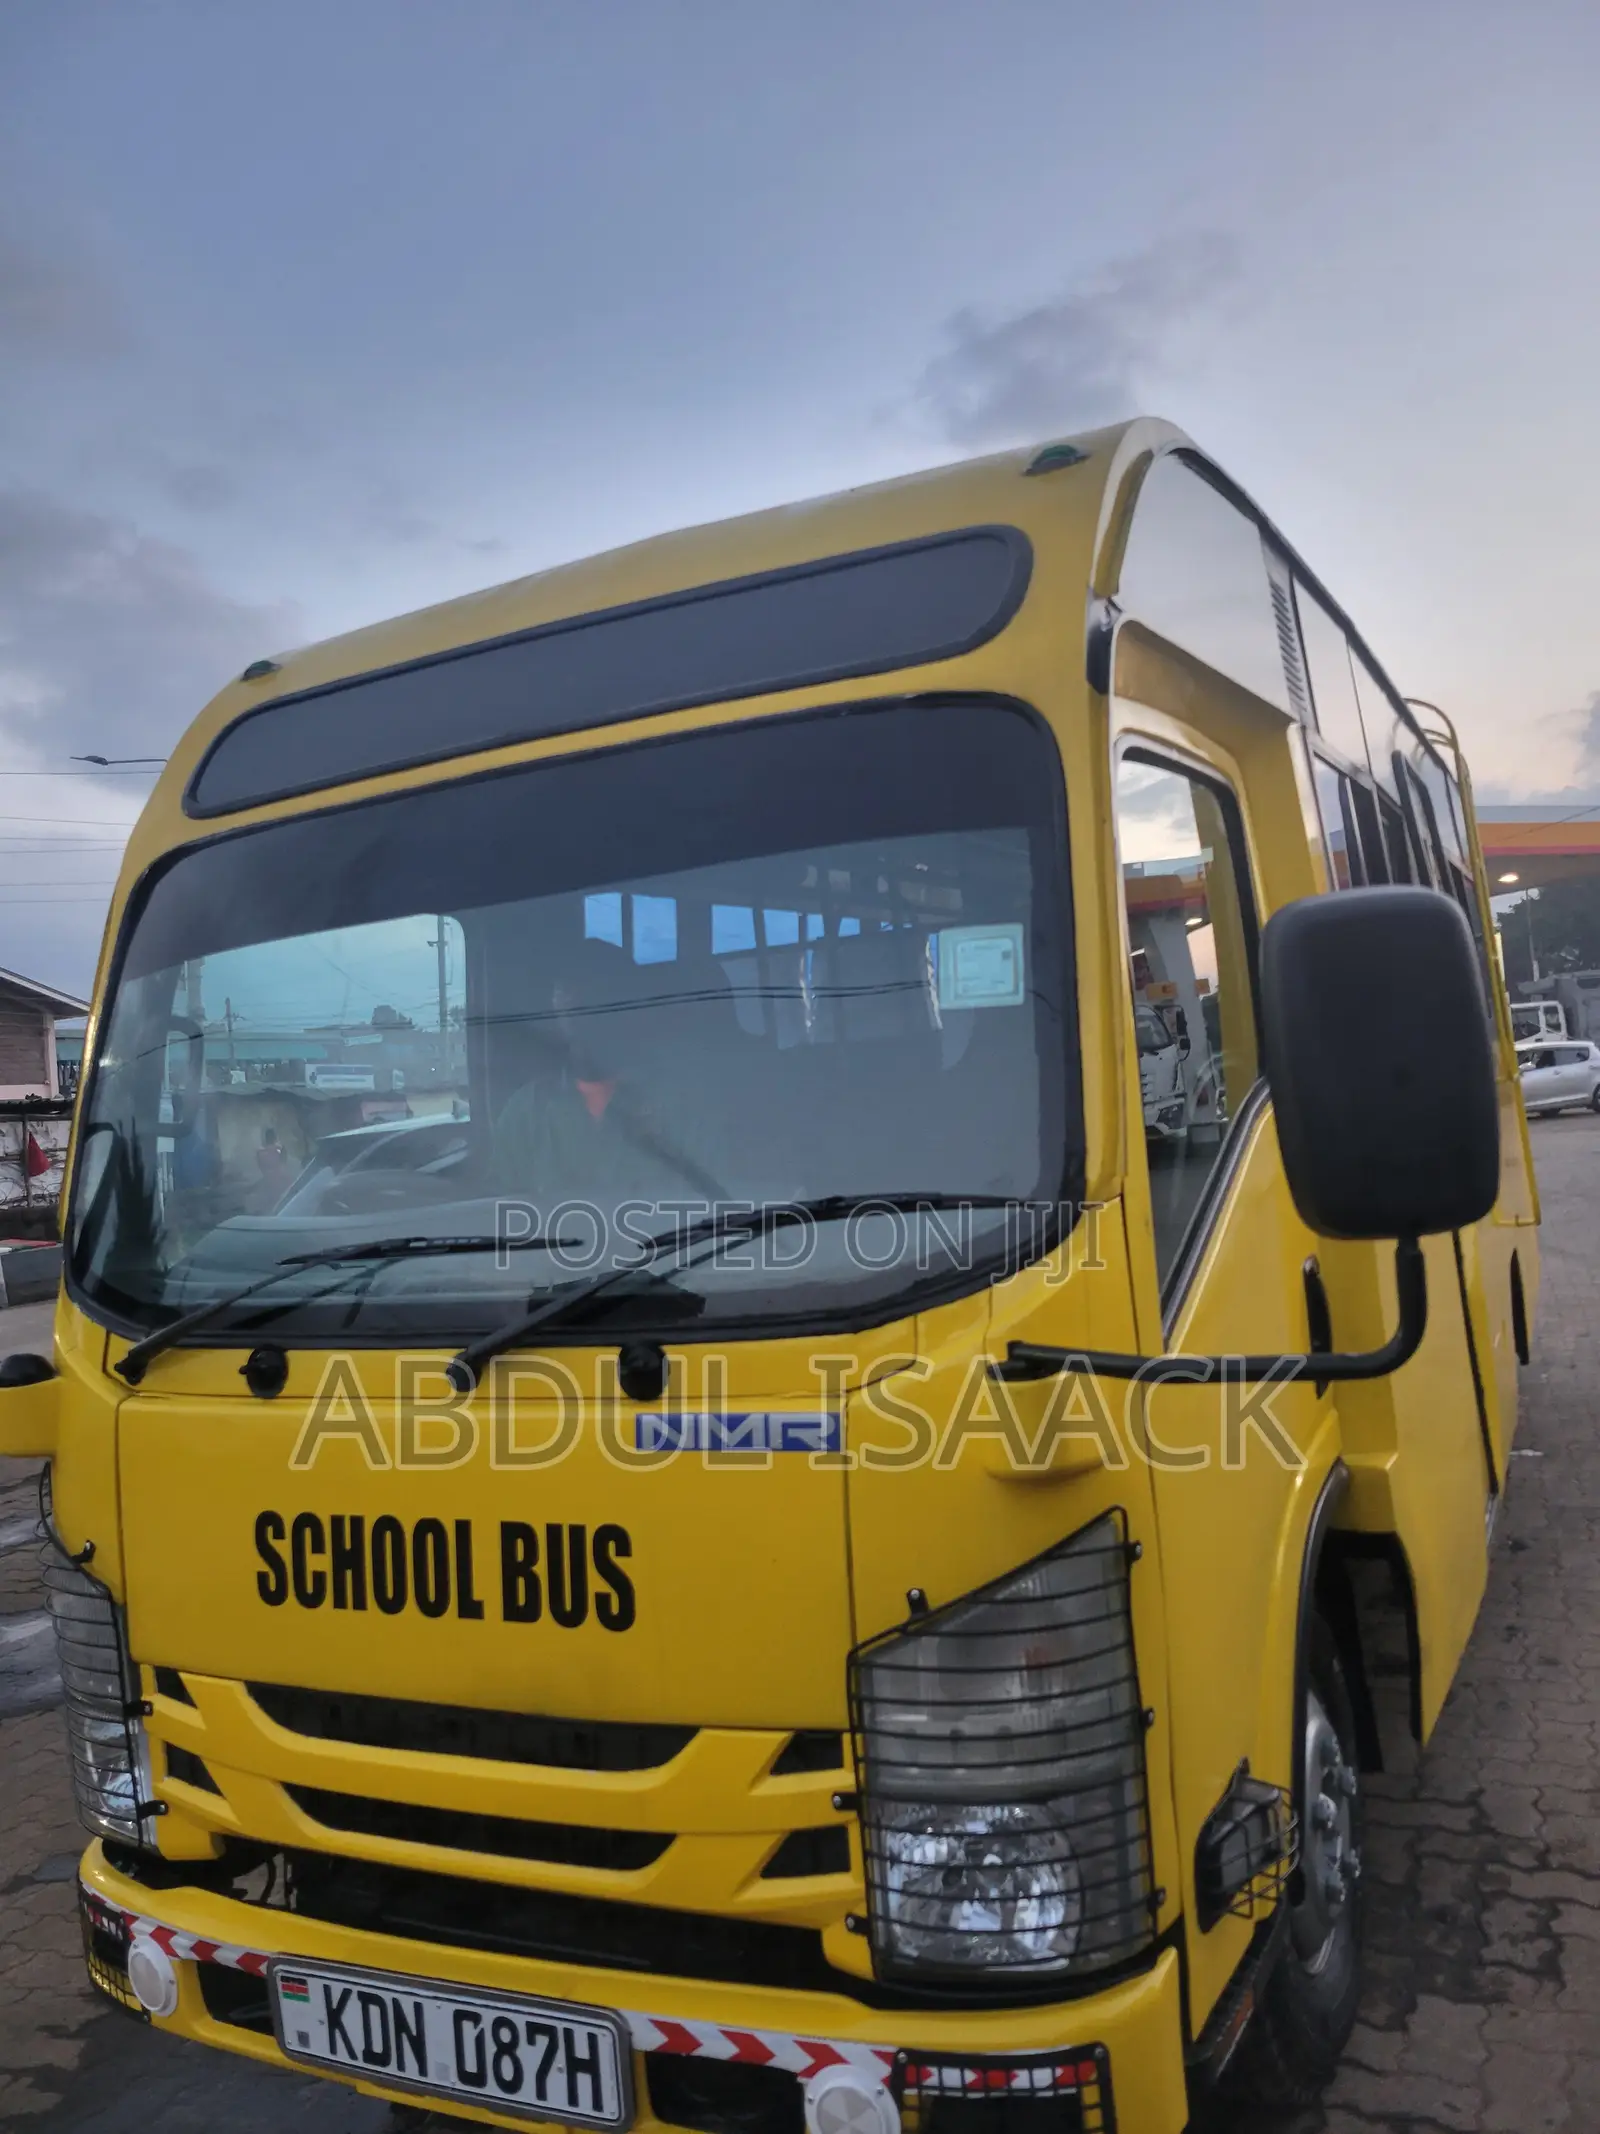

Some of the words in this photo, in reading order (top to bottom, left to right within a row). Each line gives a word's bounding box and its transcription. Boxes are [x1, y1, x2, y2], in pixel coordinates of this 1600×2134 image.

[641, 1414, 837, 1450] NMR
[253, 1509, 485, 1621] SCHOOL
[500, 1520, 637, 1633] BUS
[322, 1982, 428, 2079] KDN
[452, 2007, 605, 2114] 087H
